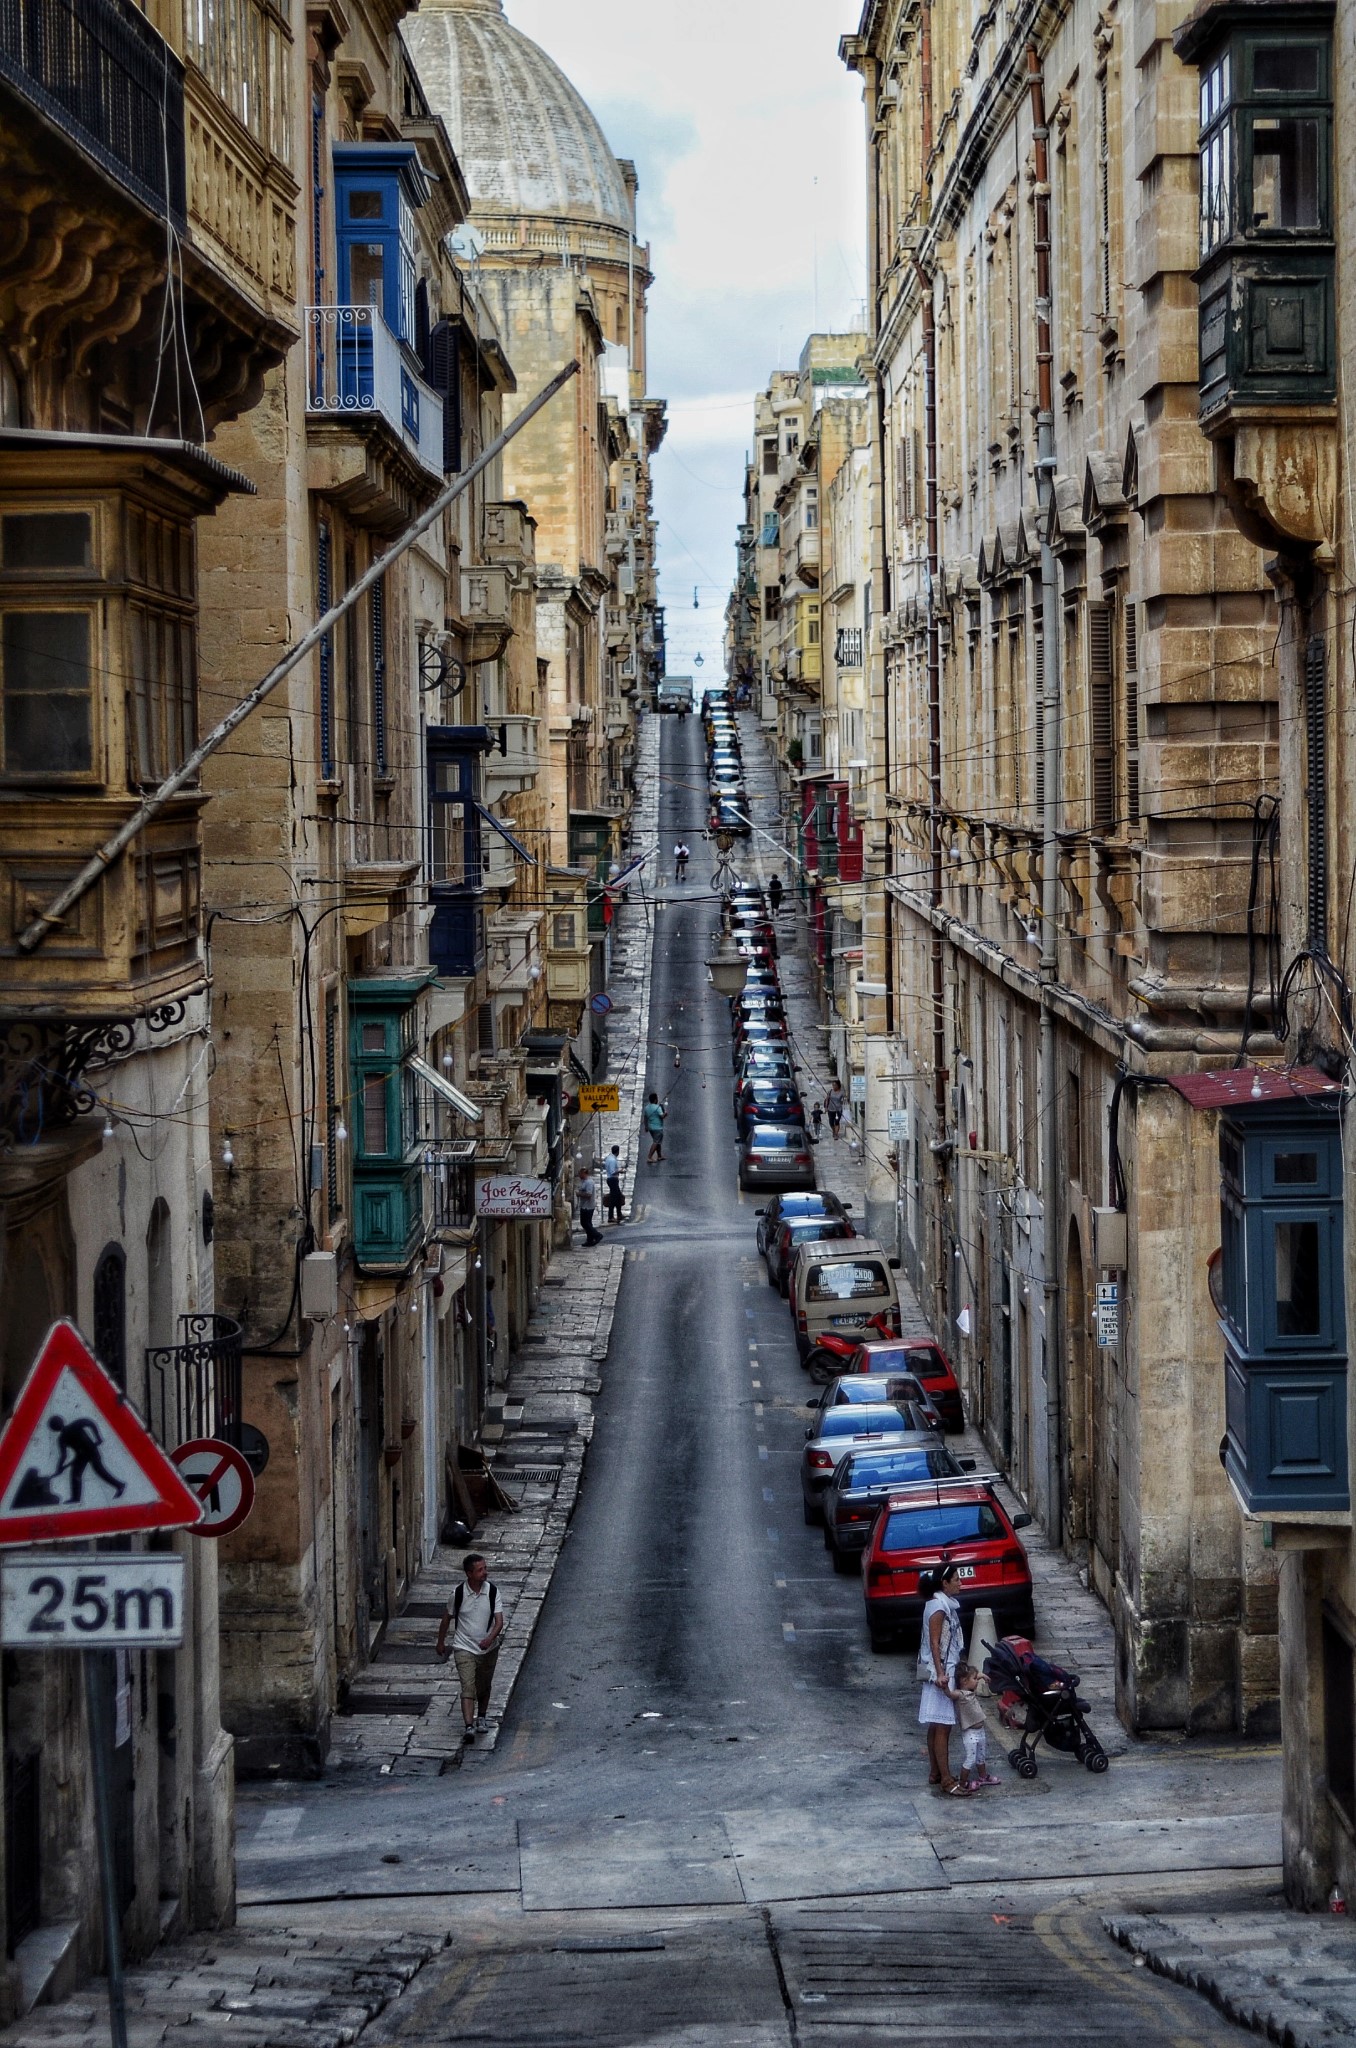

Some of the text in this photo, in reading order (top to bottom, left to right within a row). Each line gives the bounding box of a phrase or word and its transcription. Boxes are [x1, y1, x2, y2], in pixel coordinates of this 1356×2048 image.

[481, 1180, 549, 1207] Joe Frendo
[478, 1206, 547, 1214] CONFECTOERY
[959, 1566, 974, 1577] 86
[26, 1575, 174, 1633] 25m
